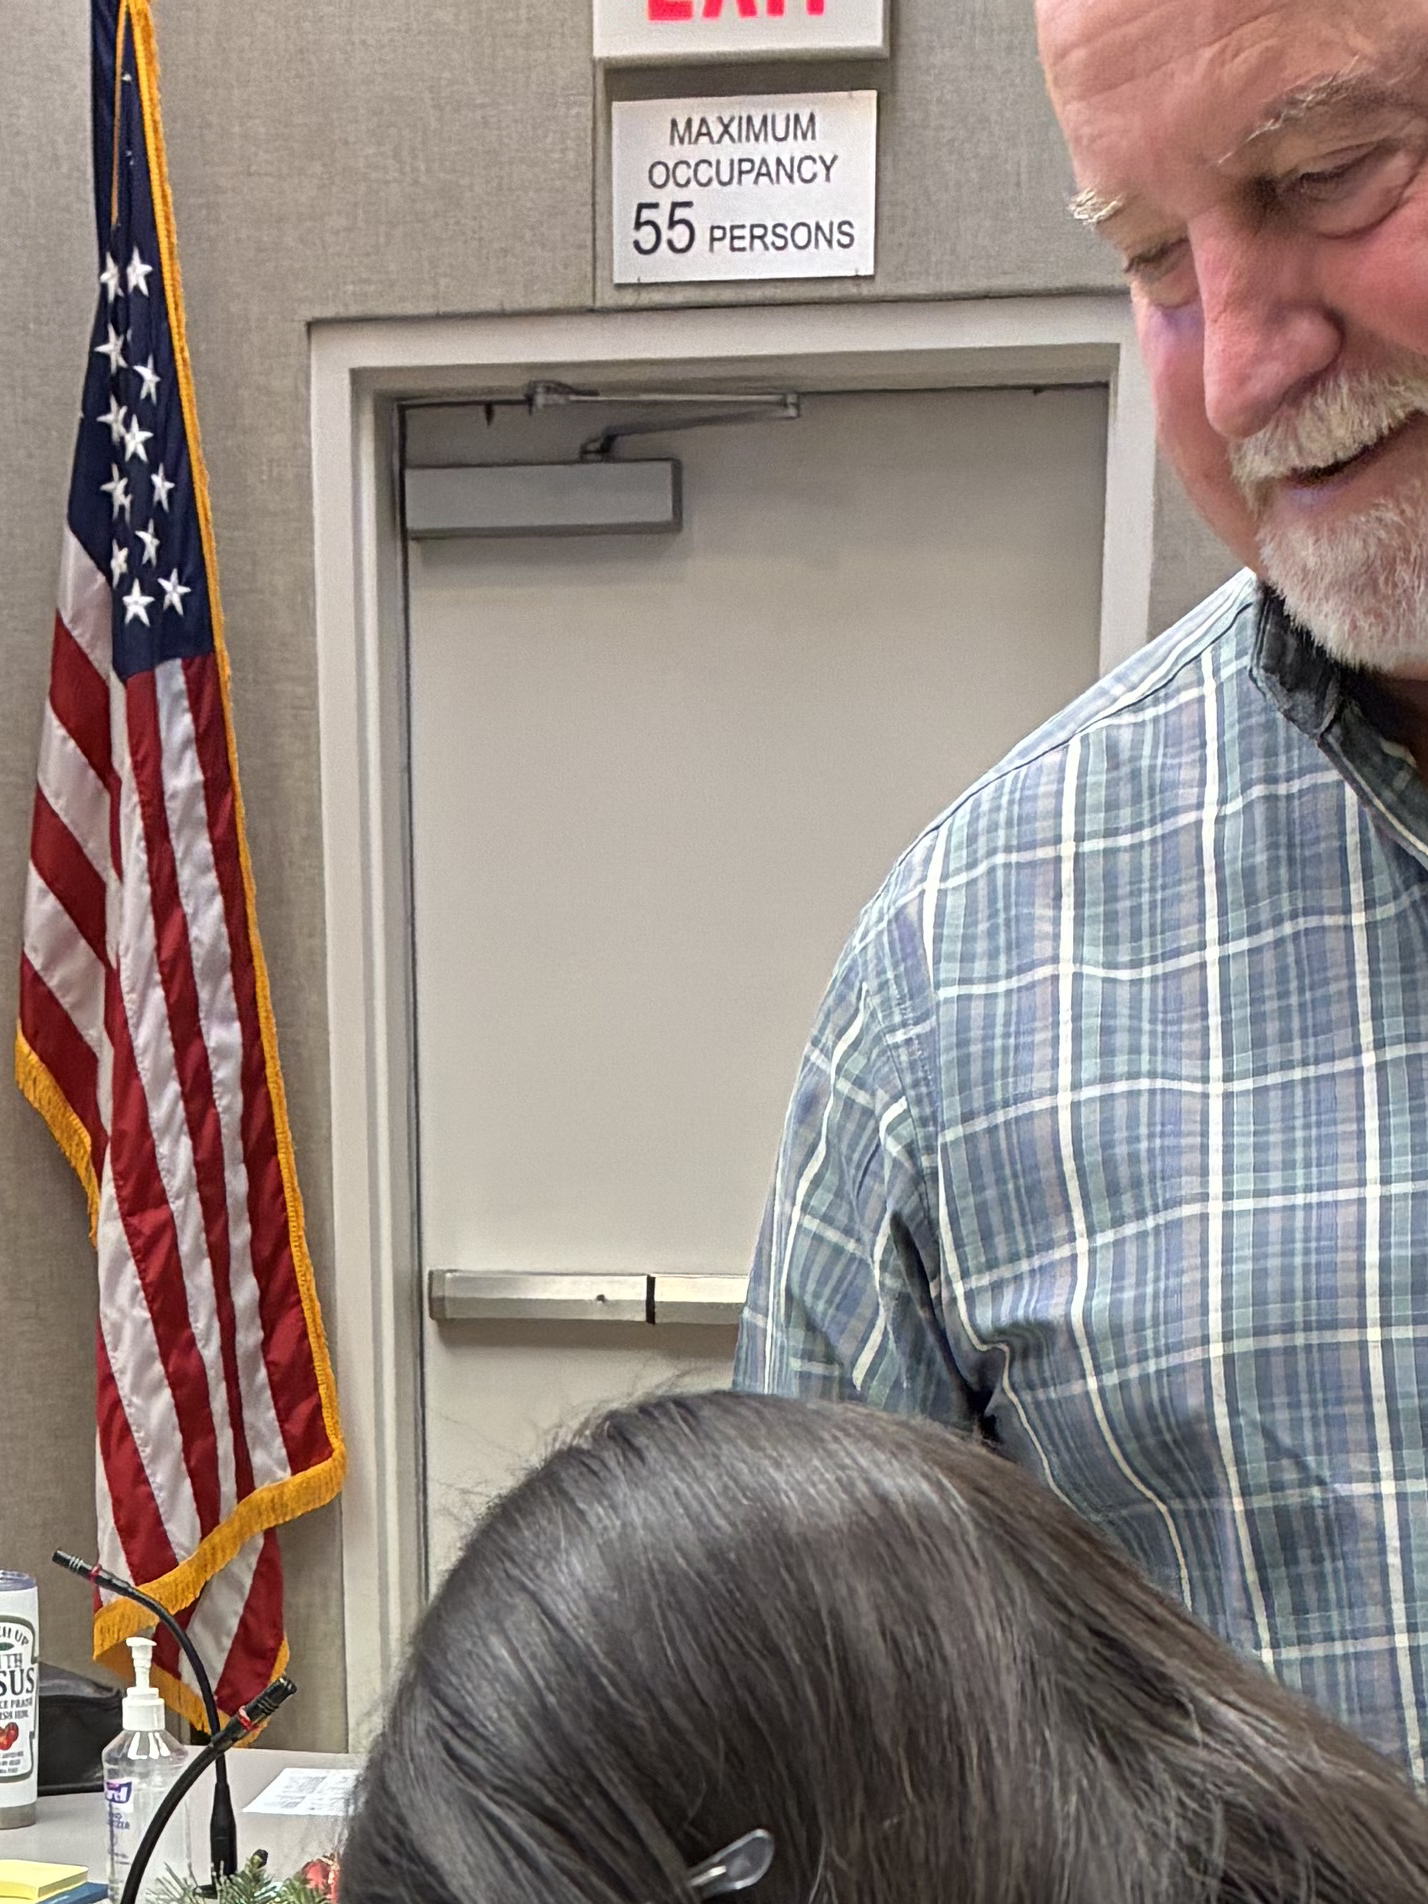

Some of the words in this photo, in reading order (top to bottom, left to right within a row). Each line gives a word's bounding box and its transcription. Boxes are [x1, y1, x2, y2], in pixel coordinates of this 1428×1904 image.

[668, 112, 817, 146] MAXIMUM
[648, 154, 839, 189] OCCUPANCY
[632, 201, 696, 255] 55
[708, 220, 855, 254] PERSONS
[15, 1629, 29, 1647] UP
